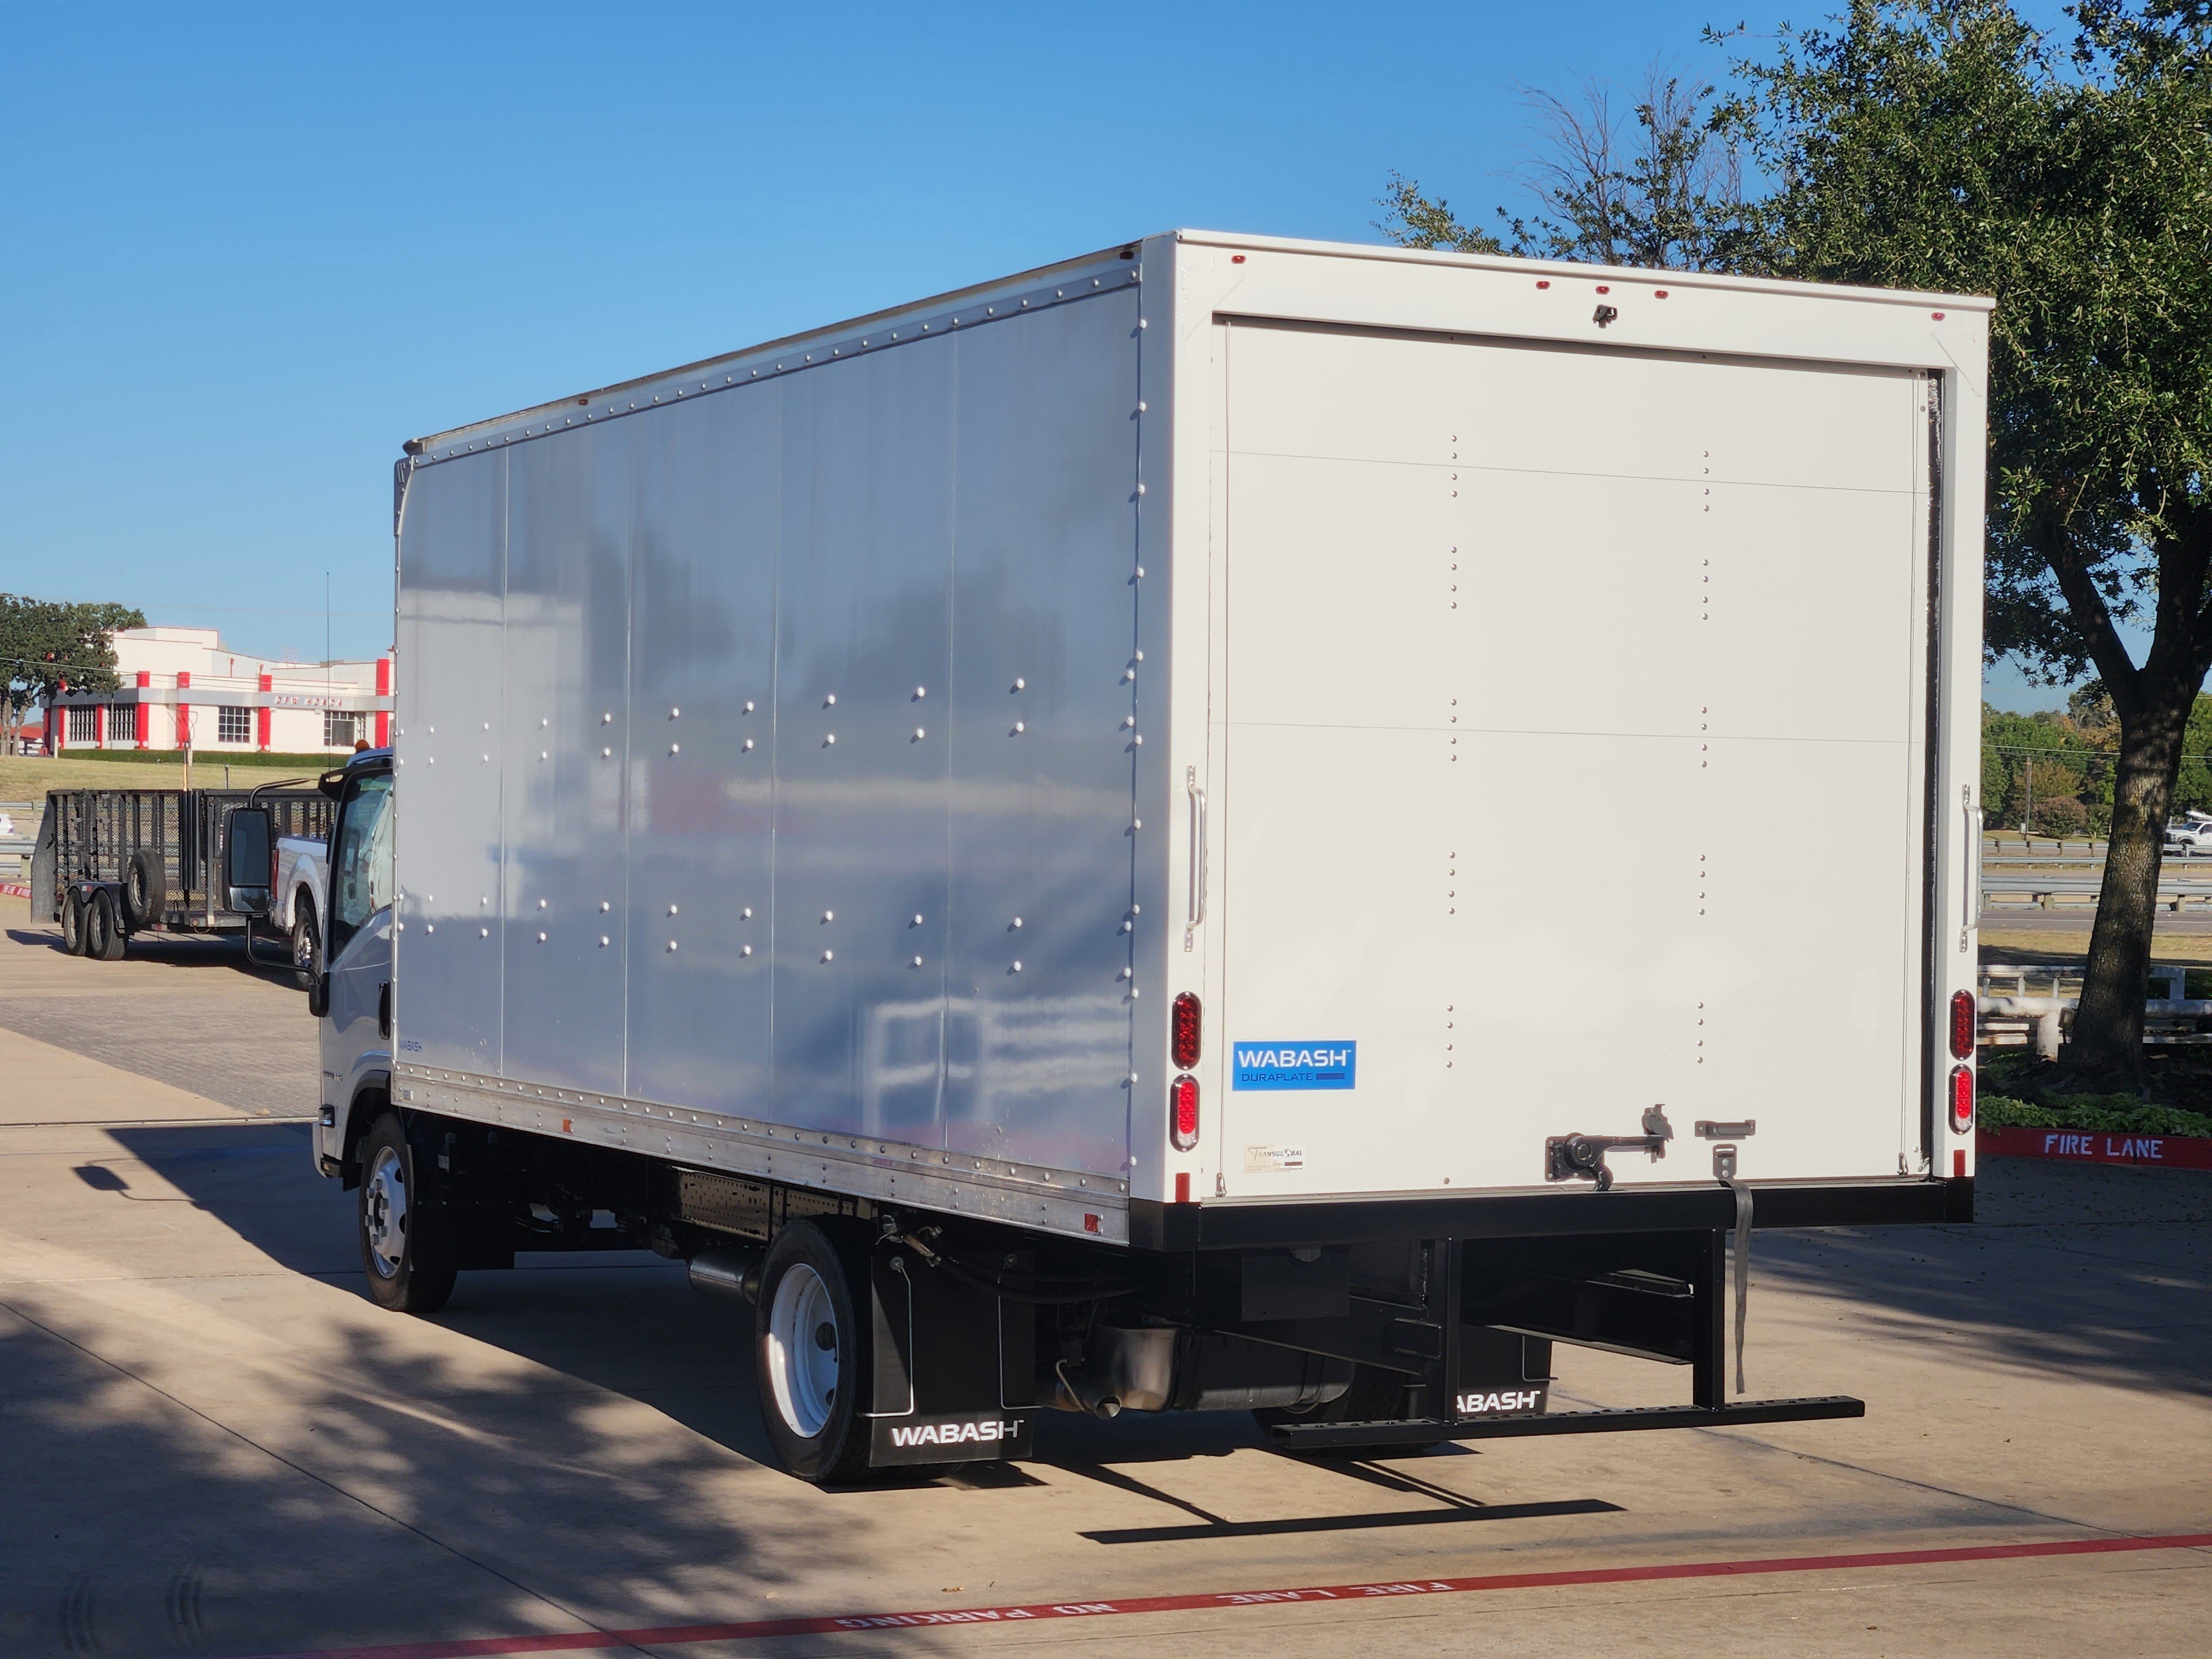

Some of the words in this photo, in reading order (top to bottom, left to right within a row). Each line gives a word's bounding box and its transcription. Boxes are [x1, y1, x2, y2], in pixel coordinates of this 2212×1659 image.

[274, 696, 299, 705] DFW
[305, 698, 342, 707] HONDA
[1238, 1050, 1346, 1068] WABASH
[1242, 1073, 1313, 1082] DURAPLATE
[2043, 1134, 2093, 1155] FIRE
[2106, 1138, 2163, 1159] LANE
[1457, 1391, 1536, 1412] ABASH
[891, 1420, 1018, 1447] WABASH
[1350, 1582, 1454, 1595] FIRE
[1217, 1590, 1337, 1604] LANE
[1054, 1604, 1118, 1614] NO
[838, 1610, 1035, 1627] PARKING
